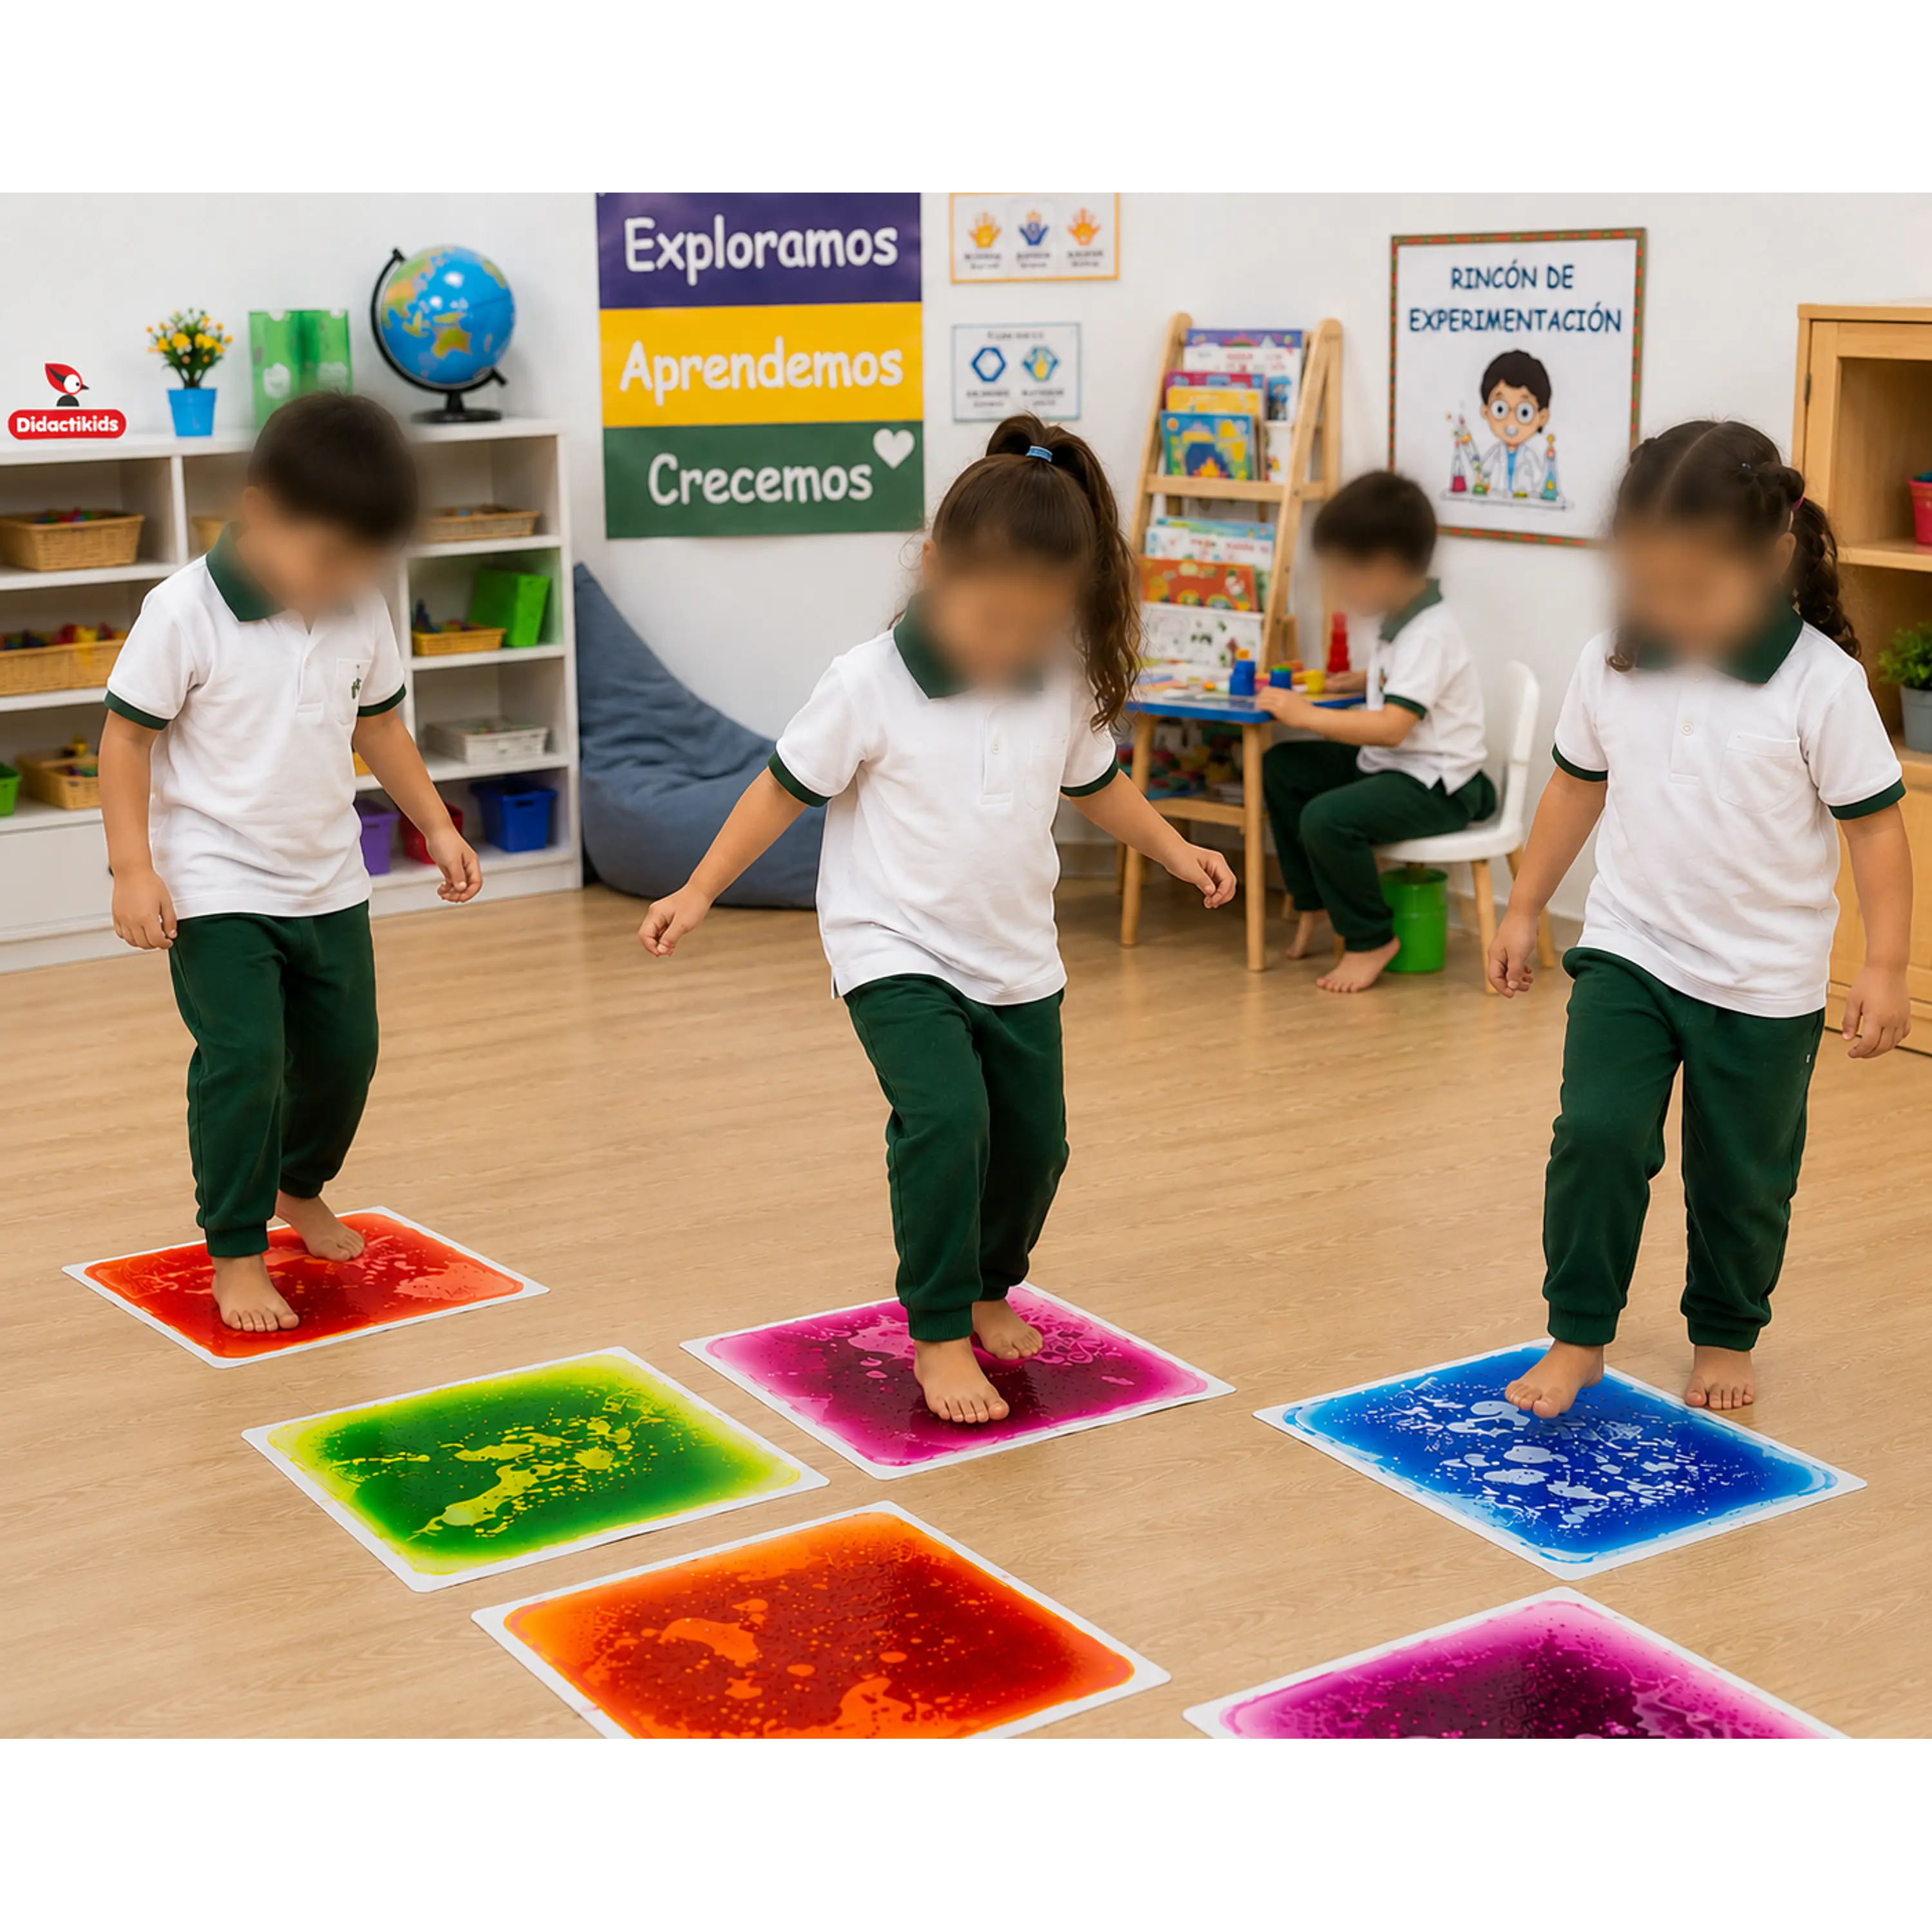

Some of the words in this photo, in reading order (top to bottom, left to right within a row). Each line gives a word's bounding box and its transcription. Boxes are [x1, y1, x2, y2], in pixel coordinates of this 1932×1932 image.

[624, 214, 898, 286] Exploramos
[1450, 259, 1538, 290] RINCÓN
[1546, 264, 1575, 290] DE
[1408, 301, 1622, 334] EXPERIMENTACIÓN
[620, 336, 903, 406] Aprendemos
[649, 453, 873, 505] Crecemos
